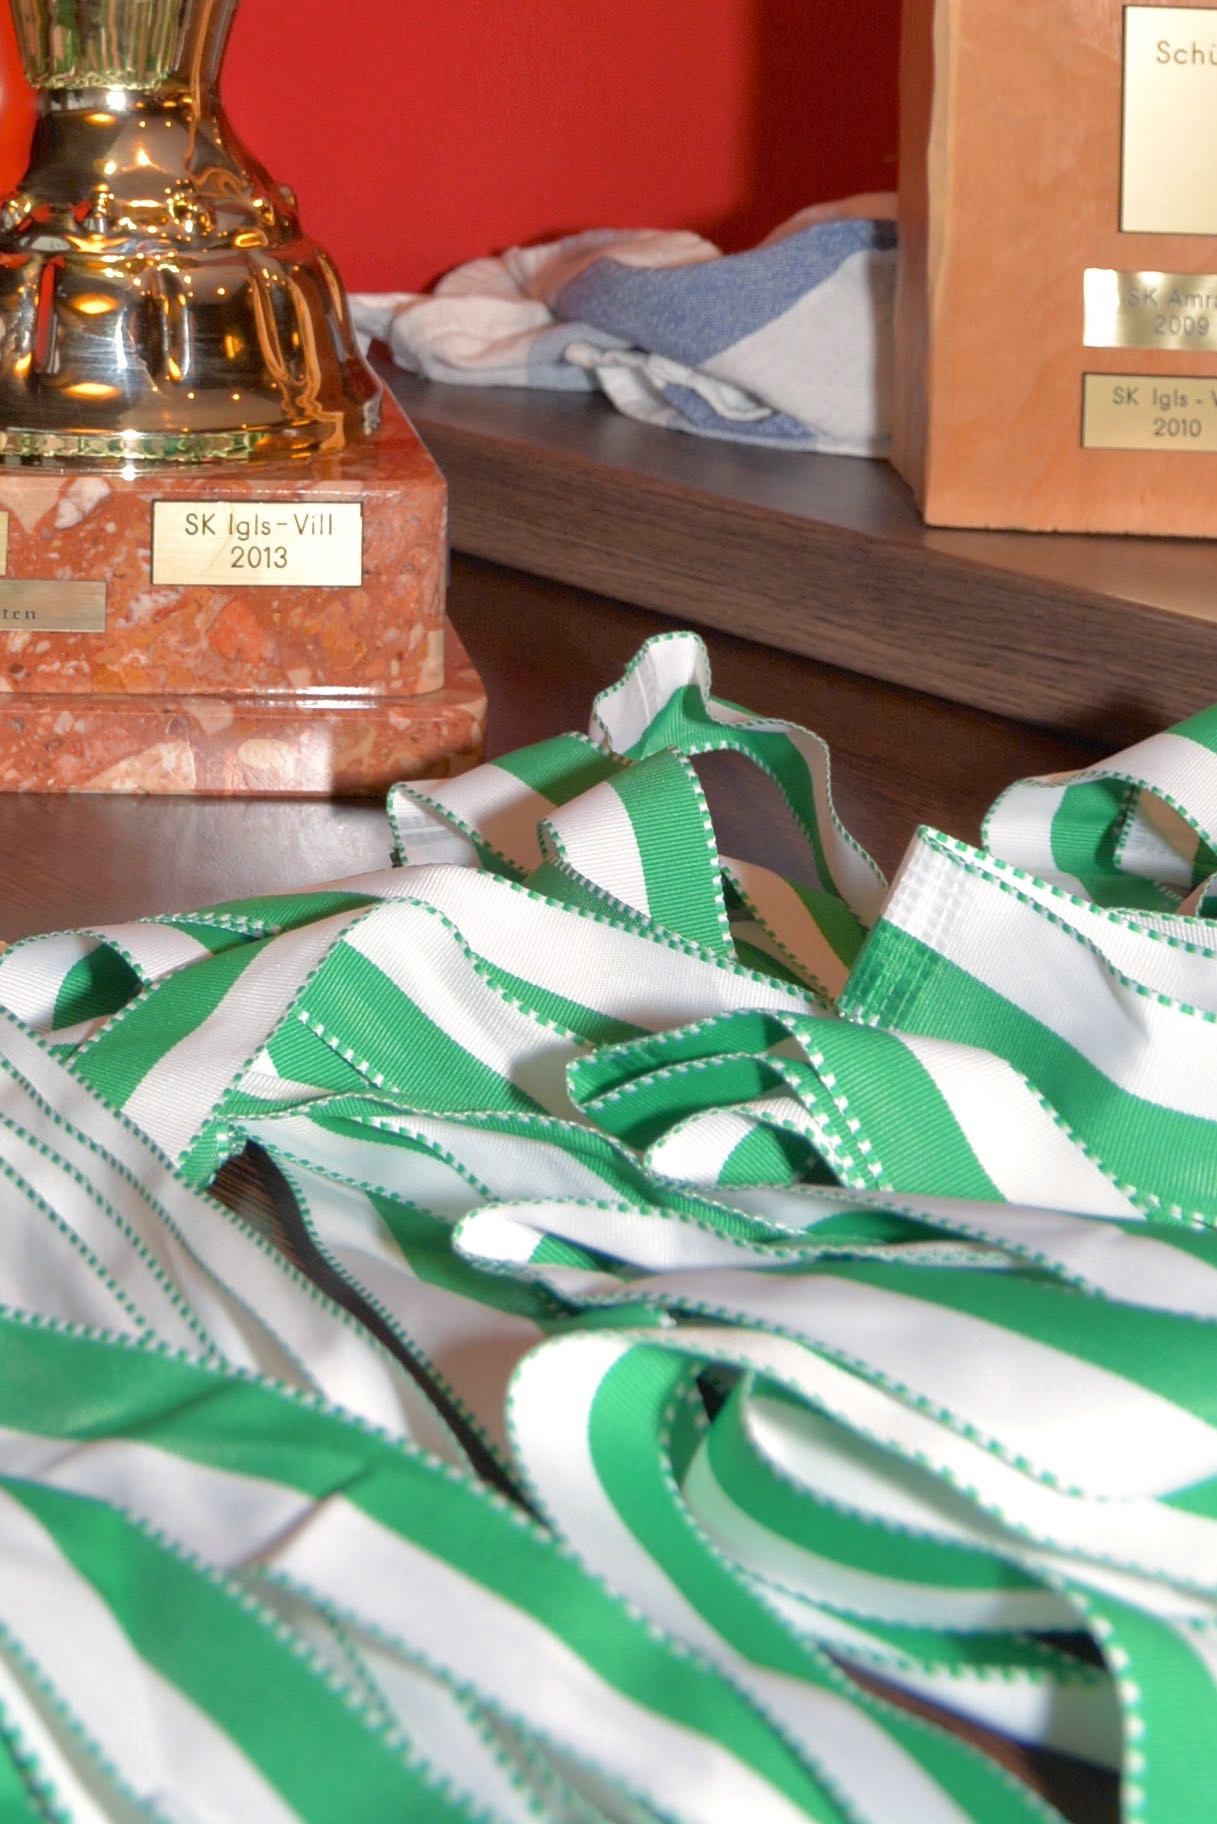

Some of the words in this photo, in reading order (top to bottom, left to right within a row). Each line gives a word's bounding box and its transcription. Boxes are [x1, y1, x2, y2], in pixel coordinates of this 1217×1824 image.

[1127, 288, 1158, 308] SK
[1154, 315, 1210, 336] 2009
[1112, 386, 1139, 406] SK
[1153, 387, 1189, 412] Igls
[1153, 417, 1202, 438] 2010
[185, 513, 216, 536] SK
[229, 513, 333, 541] Igls-Vill
[230, 546, 288, 568] 2013
